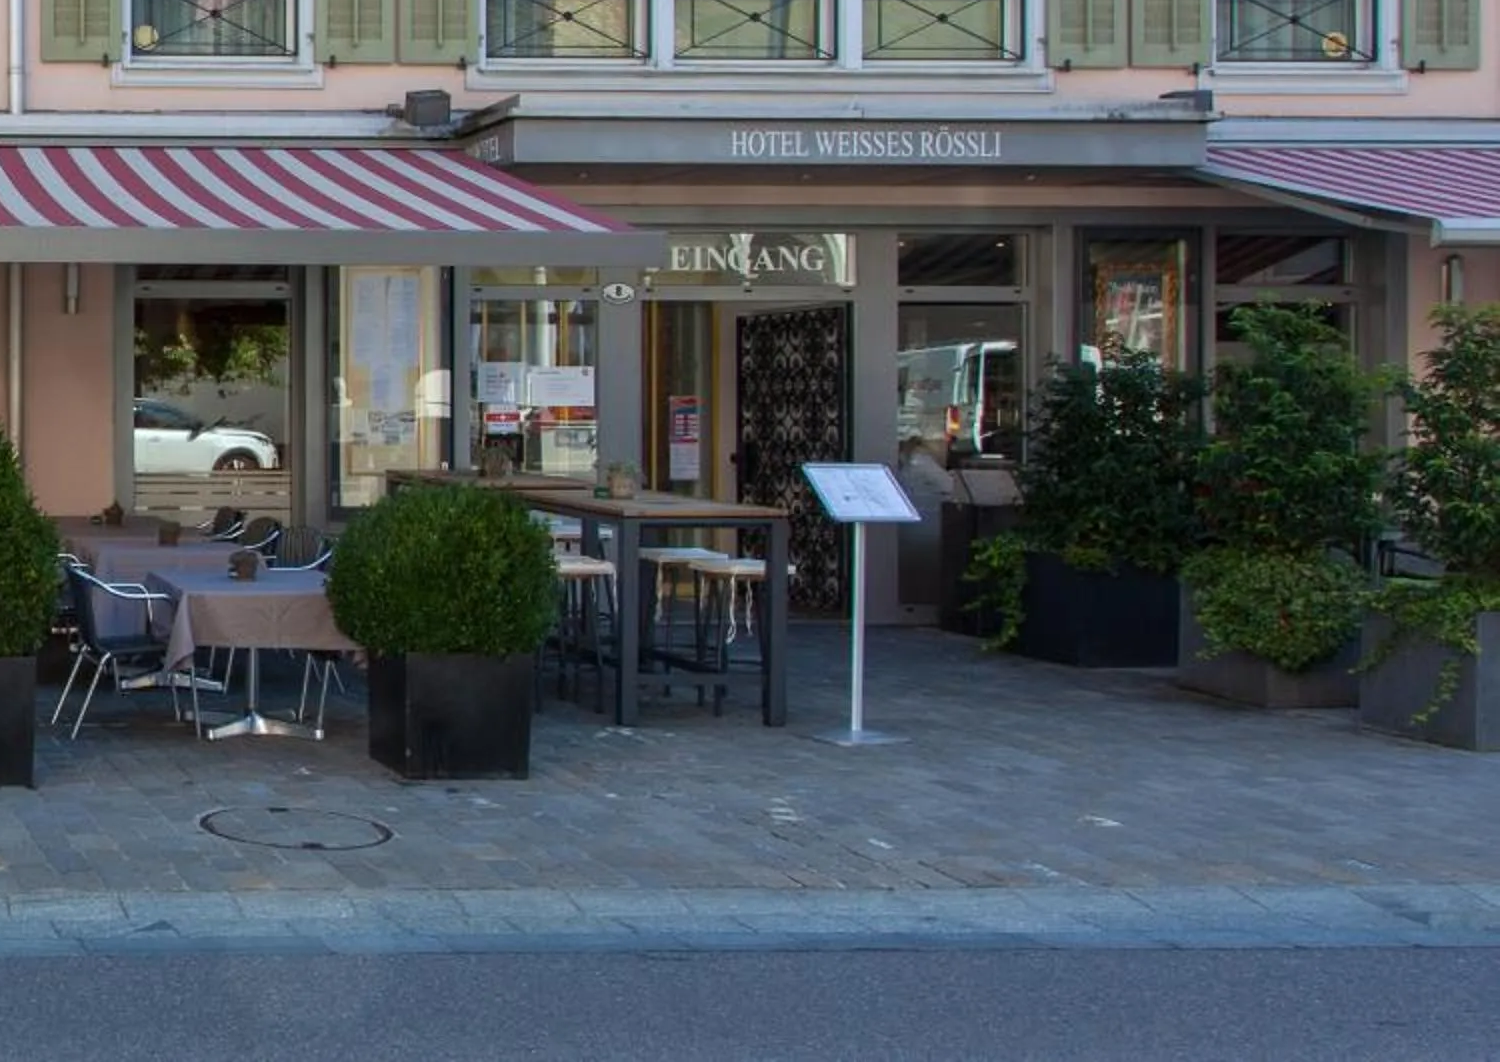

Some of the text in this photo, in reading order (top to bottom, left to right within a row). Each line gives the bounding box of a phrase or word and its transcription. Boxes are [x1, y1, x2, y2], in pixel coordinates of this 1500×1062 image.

[731, 125, 1002, 158] HOTEL WEISSES RÖSSLI
[670, 244, 824, 275] EINGANG
